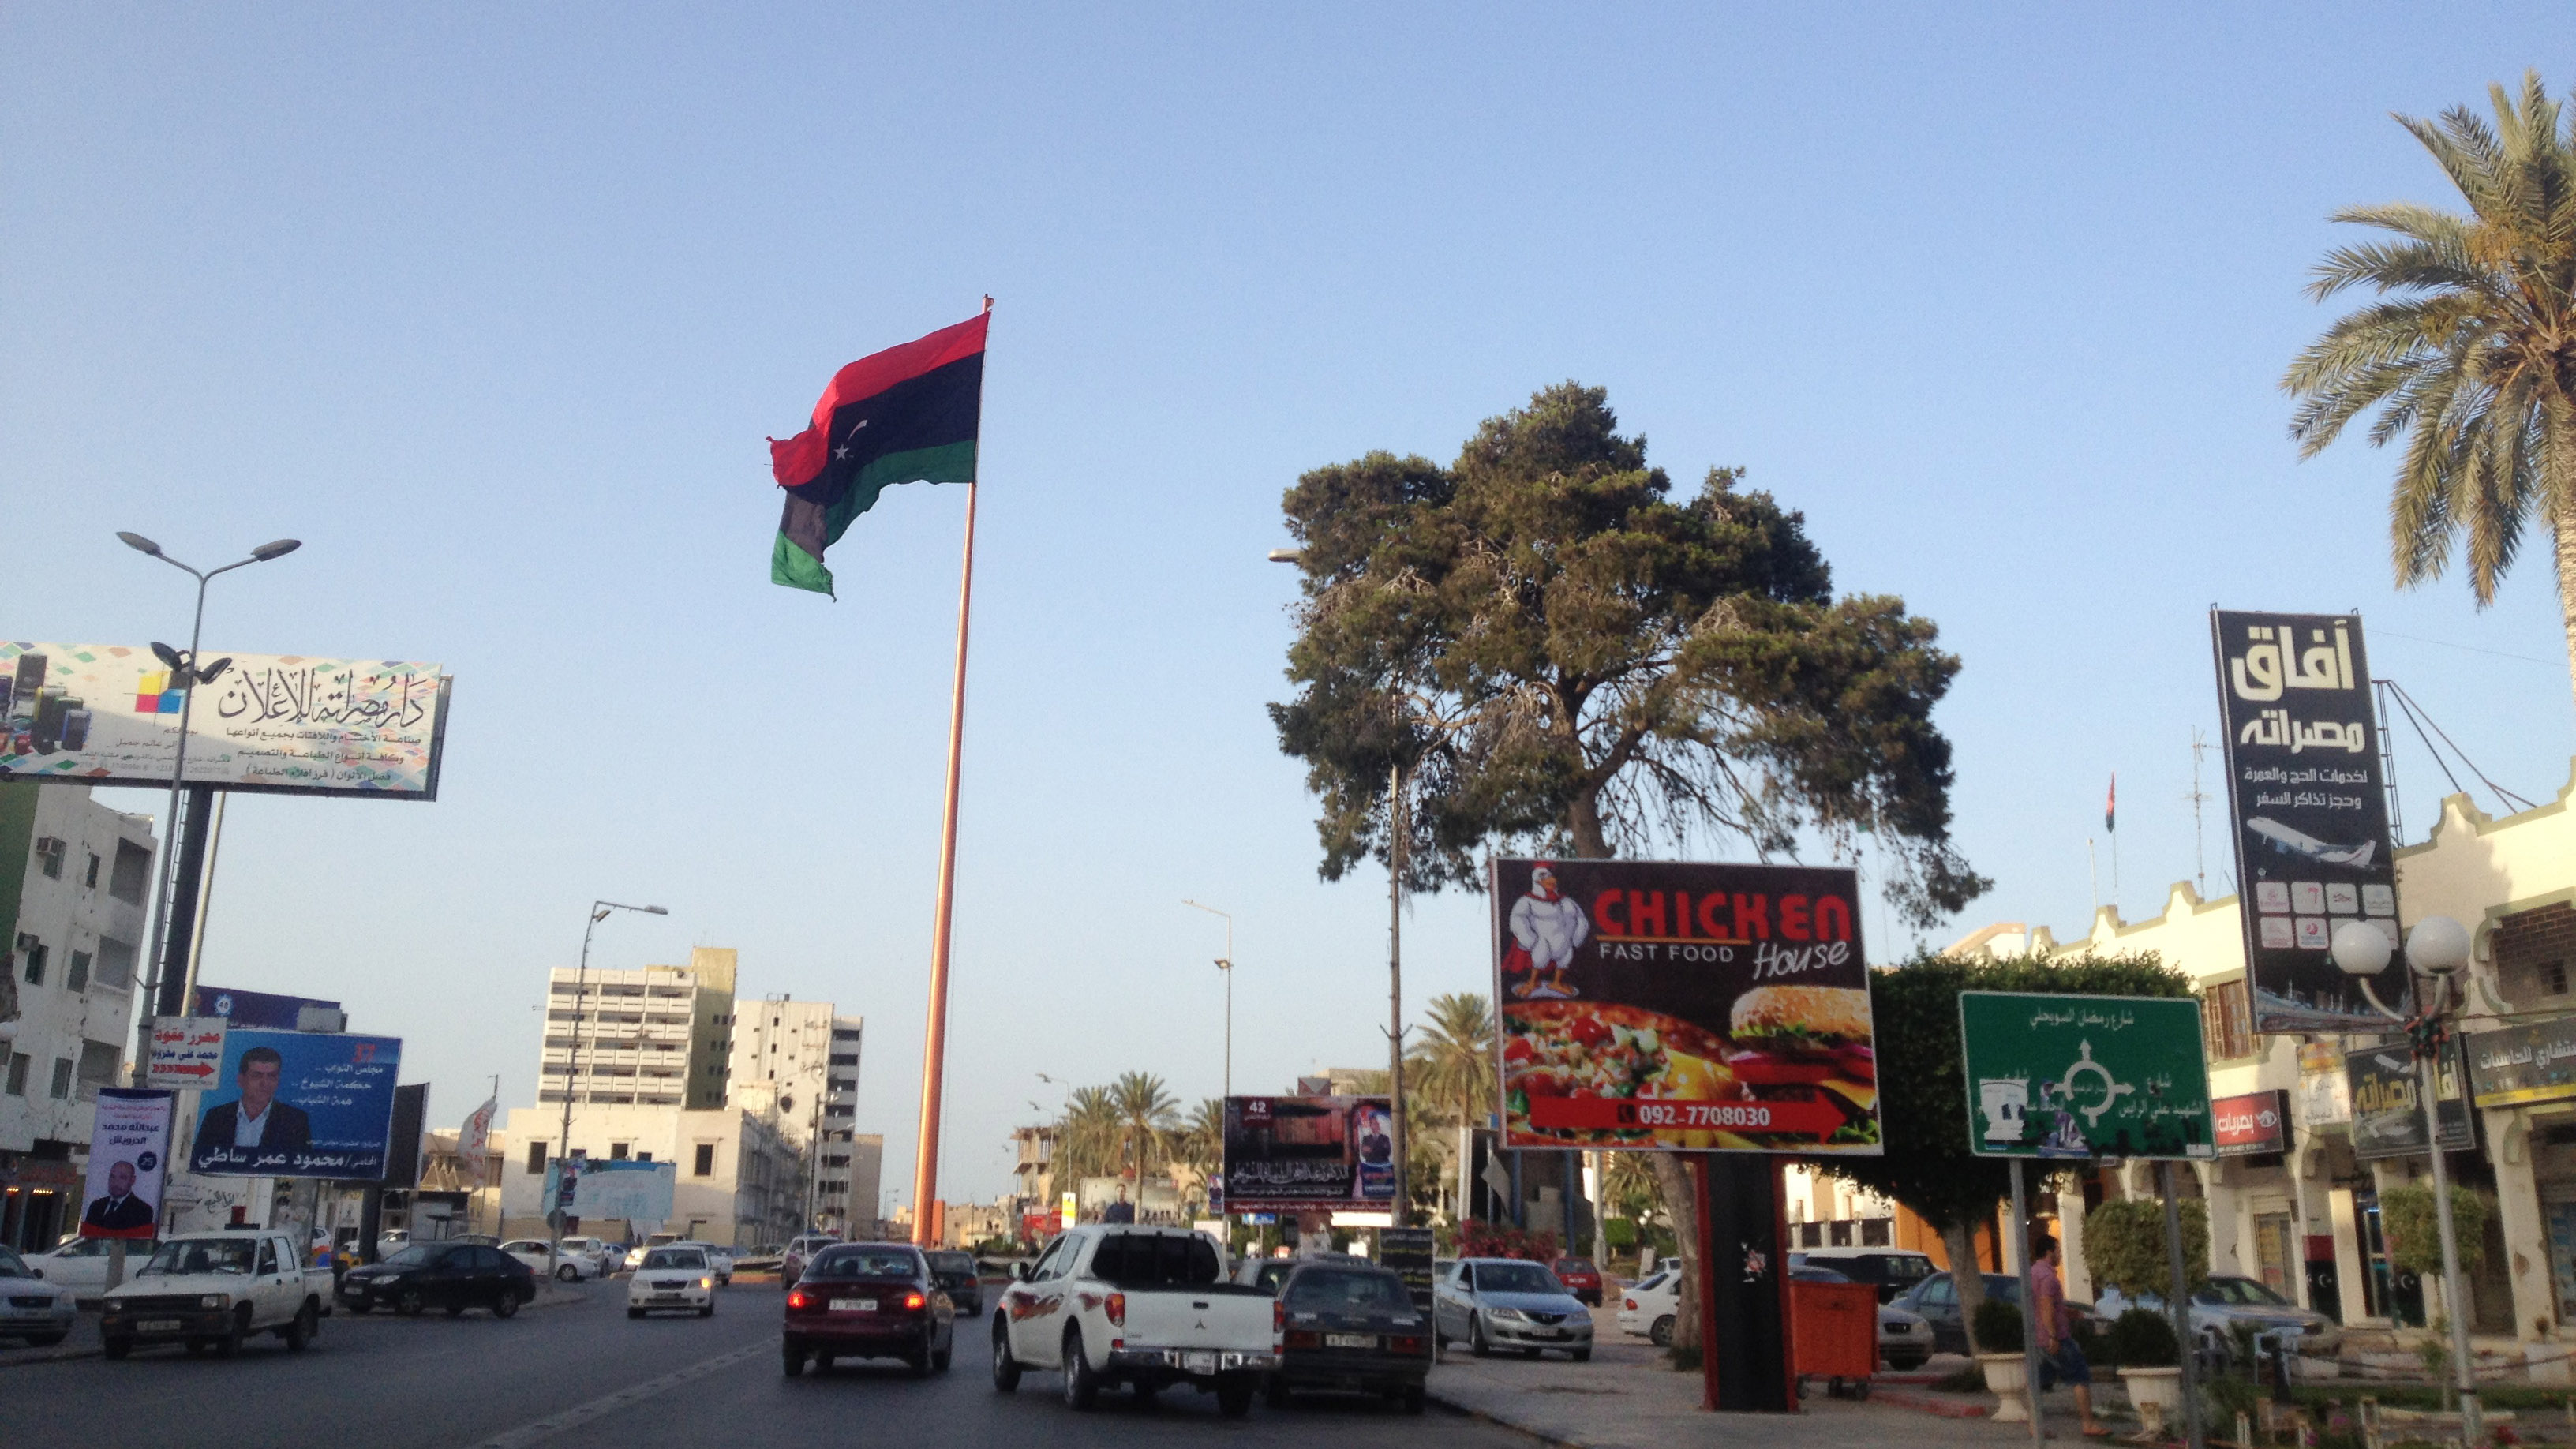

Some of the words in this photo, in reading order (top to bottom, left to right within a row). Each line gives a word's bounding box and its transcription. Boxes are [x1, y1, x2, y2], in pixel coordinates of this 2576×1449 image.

[2231, 620, 2355, 702] أفاق
[2240, 710, 2365, 754] مصراته
[2290, 768, 2317, 784] الحج
[2256, 791, 2291, 807] السفر
[2293, 792, 2327, 808] تذاكر
[2329, 793, 2362, 810] وحجز
[1600, 943, 1659, 960] FAST
[1668, 945, 1735, 963] FOOD
[1753, 940, 1851, 980] House
[1249, 1101, 1267, 1114] 42
[1639, 1105, 1771, 1127] 092-7708030
